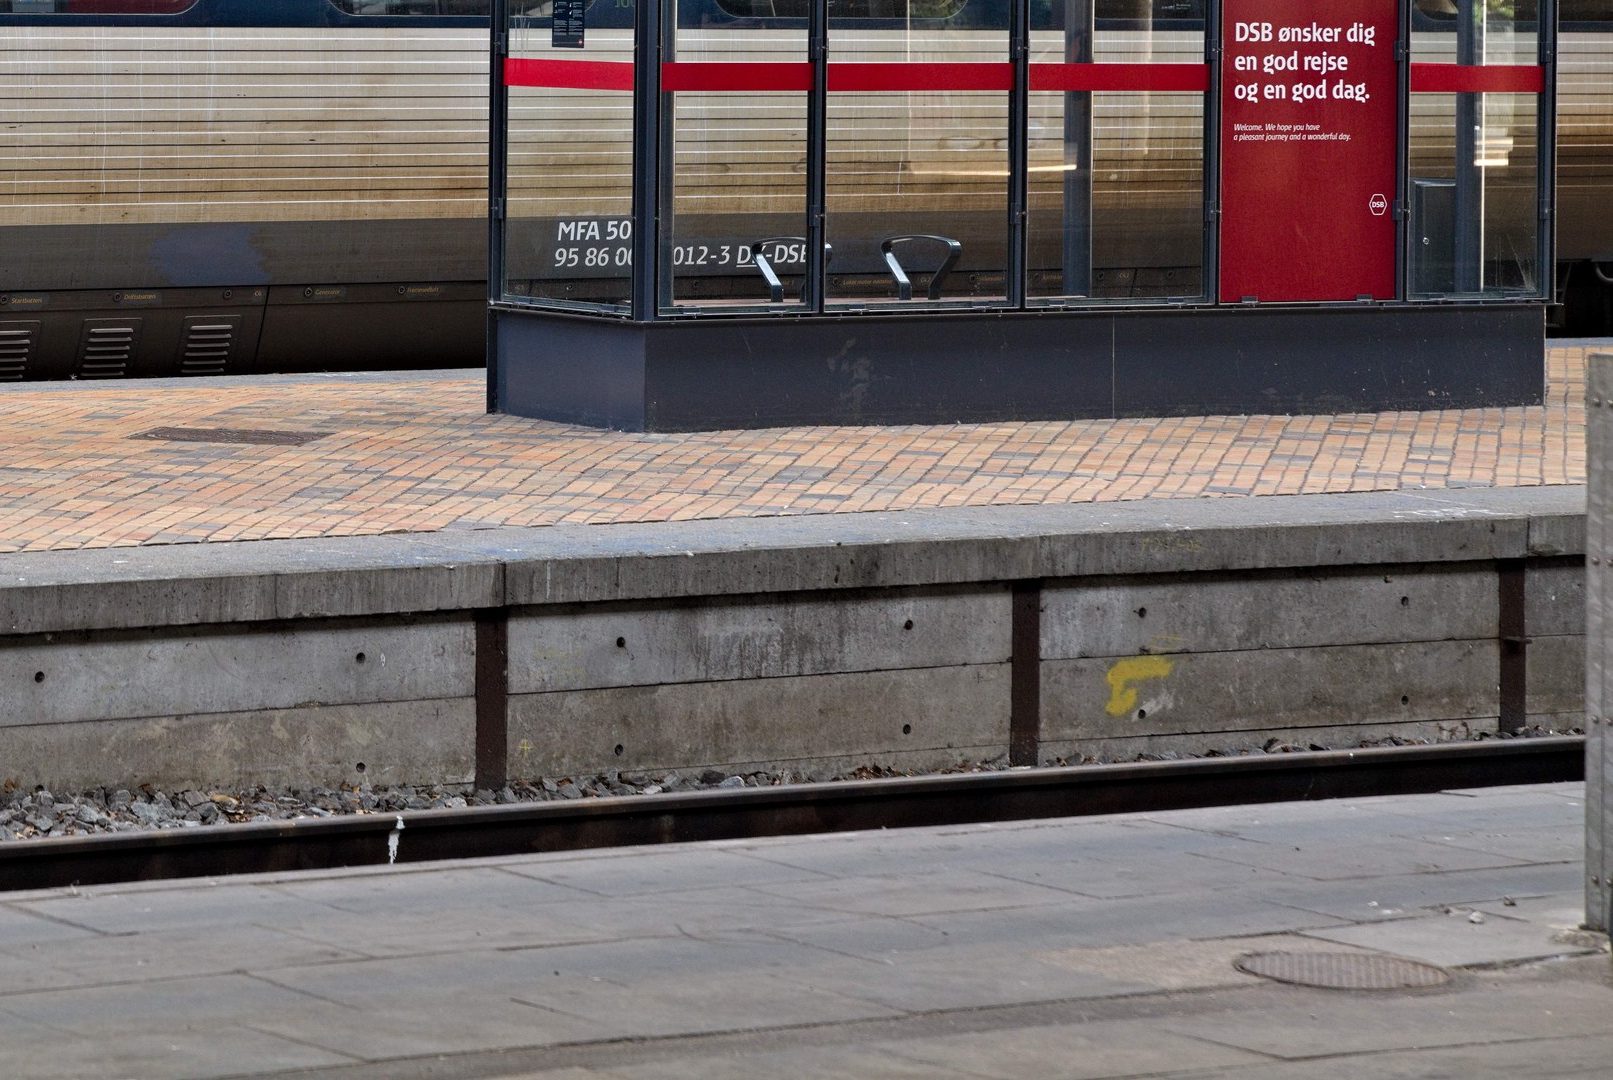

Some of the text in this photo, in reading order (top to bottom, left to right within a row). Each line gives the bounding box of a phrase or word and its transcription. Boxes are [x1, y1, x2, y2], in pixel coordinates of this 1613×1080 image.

[1235, 22, 1375, 46] DSB ønsker dig
[1234, 50, 1348, 75] en god rejse
[1234, 79, 1370, 103] og en god dag.
[1234, 123, 1321, 133] Welcome. We hope you have
[1238, 133, 1265, 142] pleasant
[1265, 133, 1288, 142] journey
[1289, 133, 1301, 141] and
[1307, 133, 1338, 141] wonderful
[1338, 133, 1352, 142] day.
[557, 220, 600, 241] MFA
[554, 247, 580, 267] 95
[585, 247, 610, 267] 86
